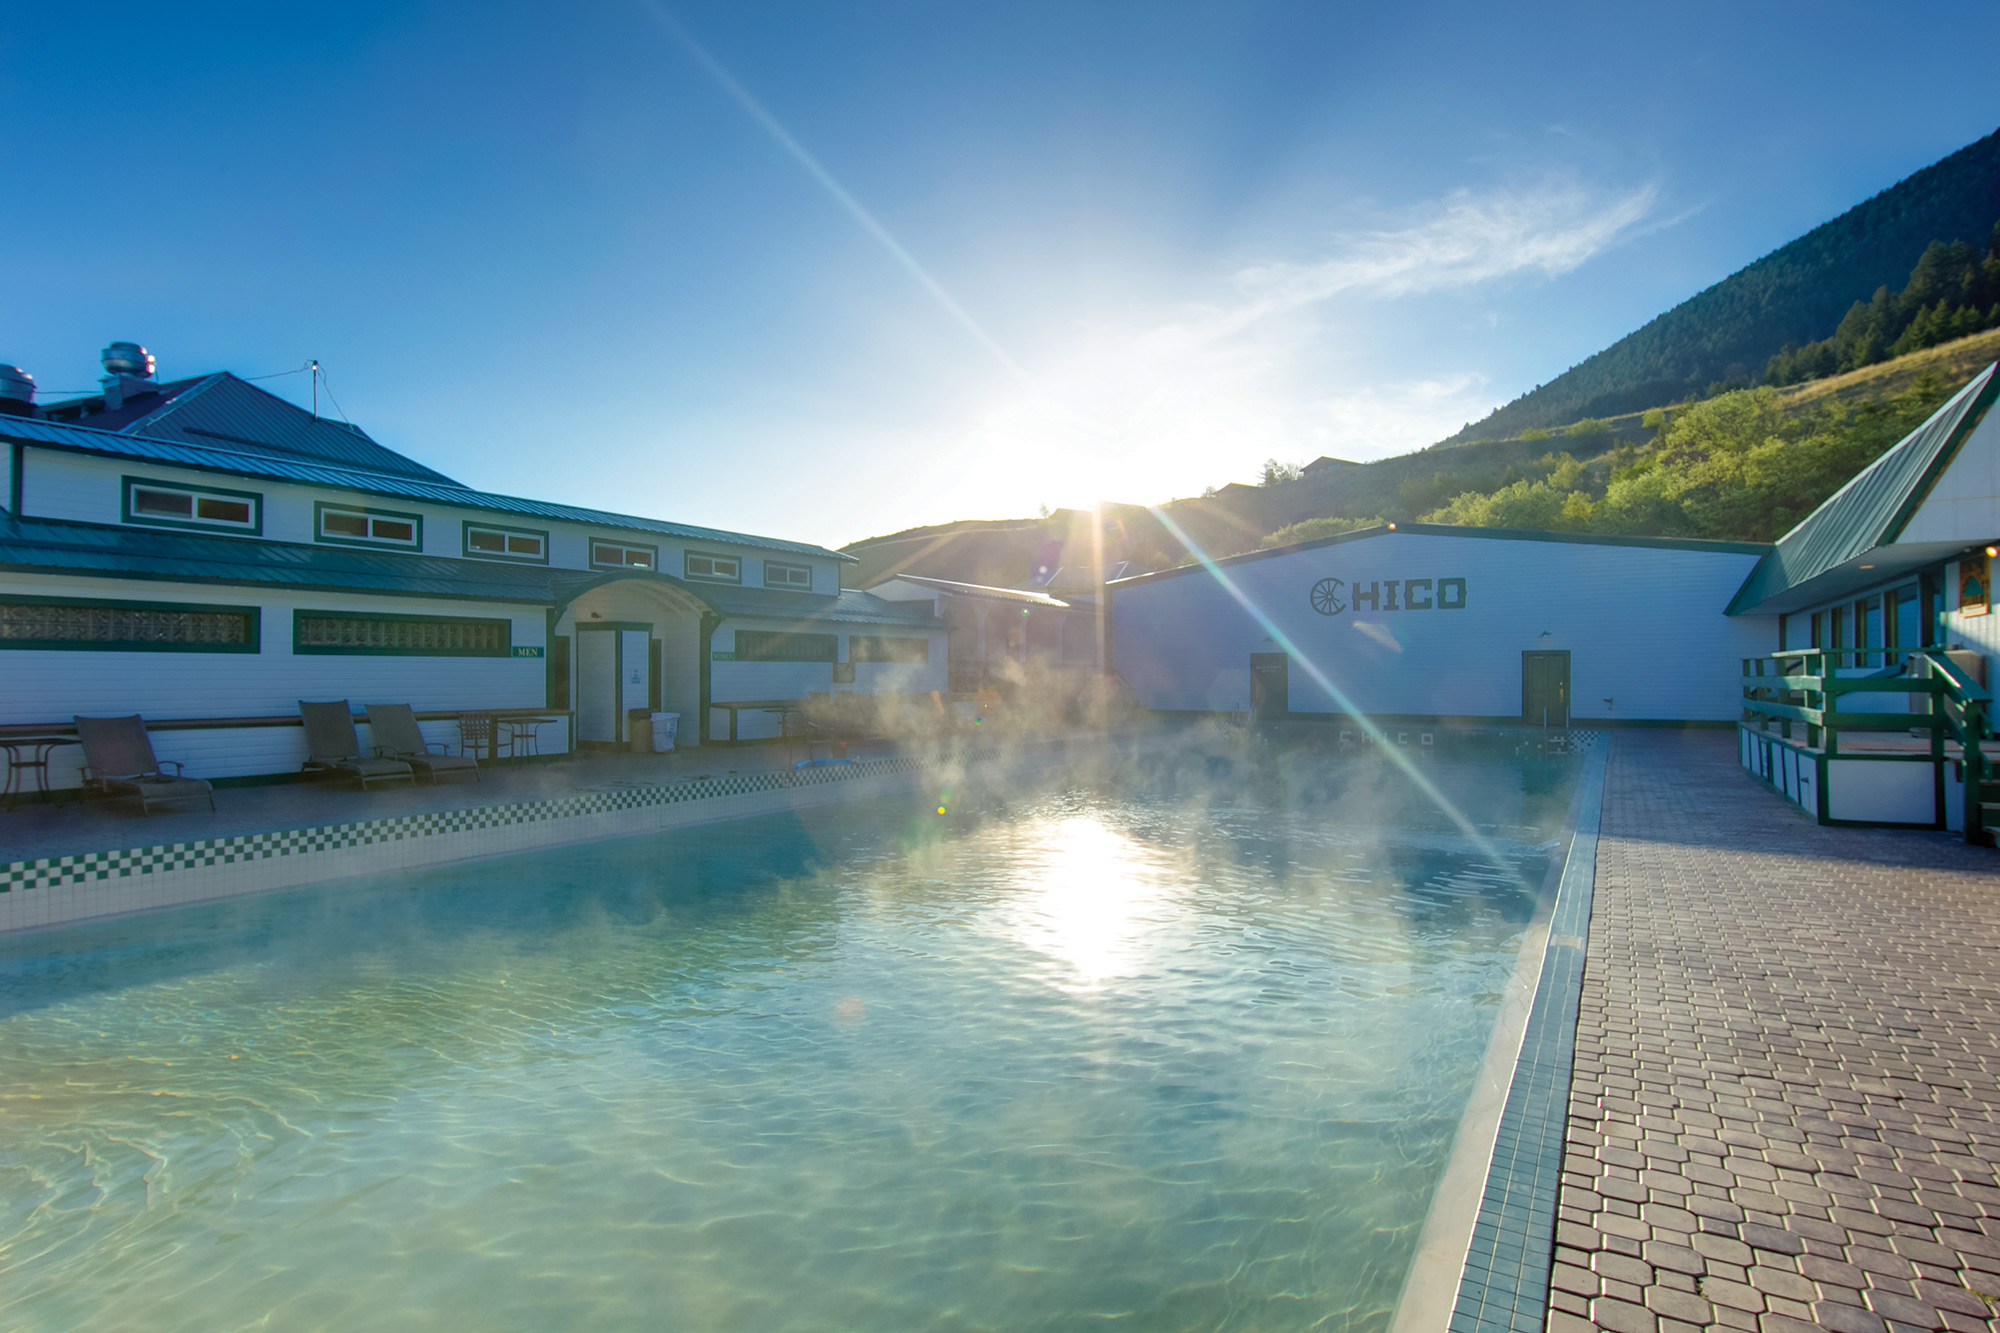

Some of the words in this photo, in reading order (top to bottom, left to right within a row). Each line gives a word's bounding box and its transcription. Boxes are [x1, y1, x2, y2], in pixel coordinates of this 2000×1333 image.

[1310, 577, 1467, 616] CHICO
[518, 648, 538, 656] MEN
[1339, 730, 1434, 745] CHICO
